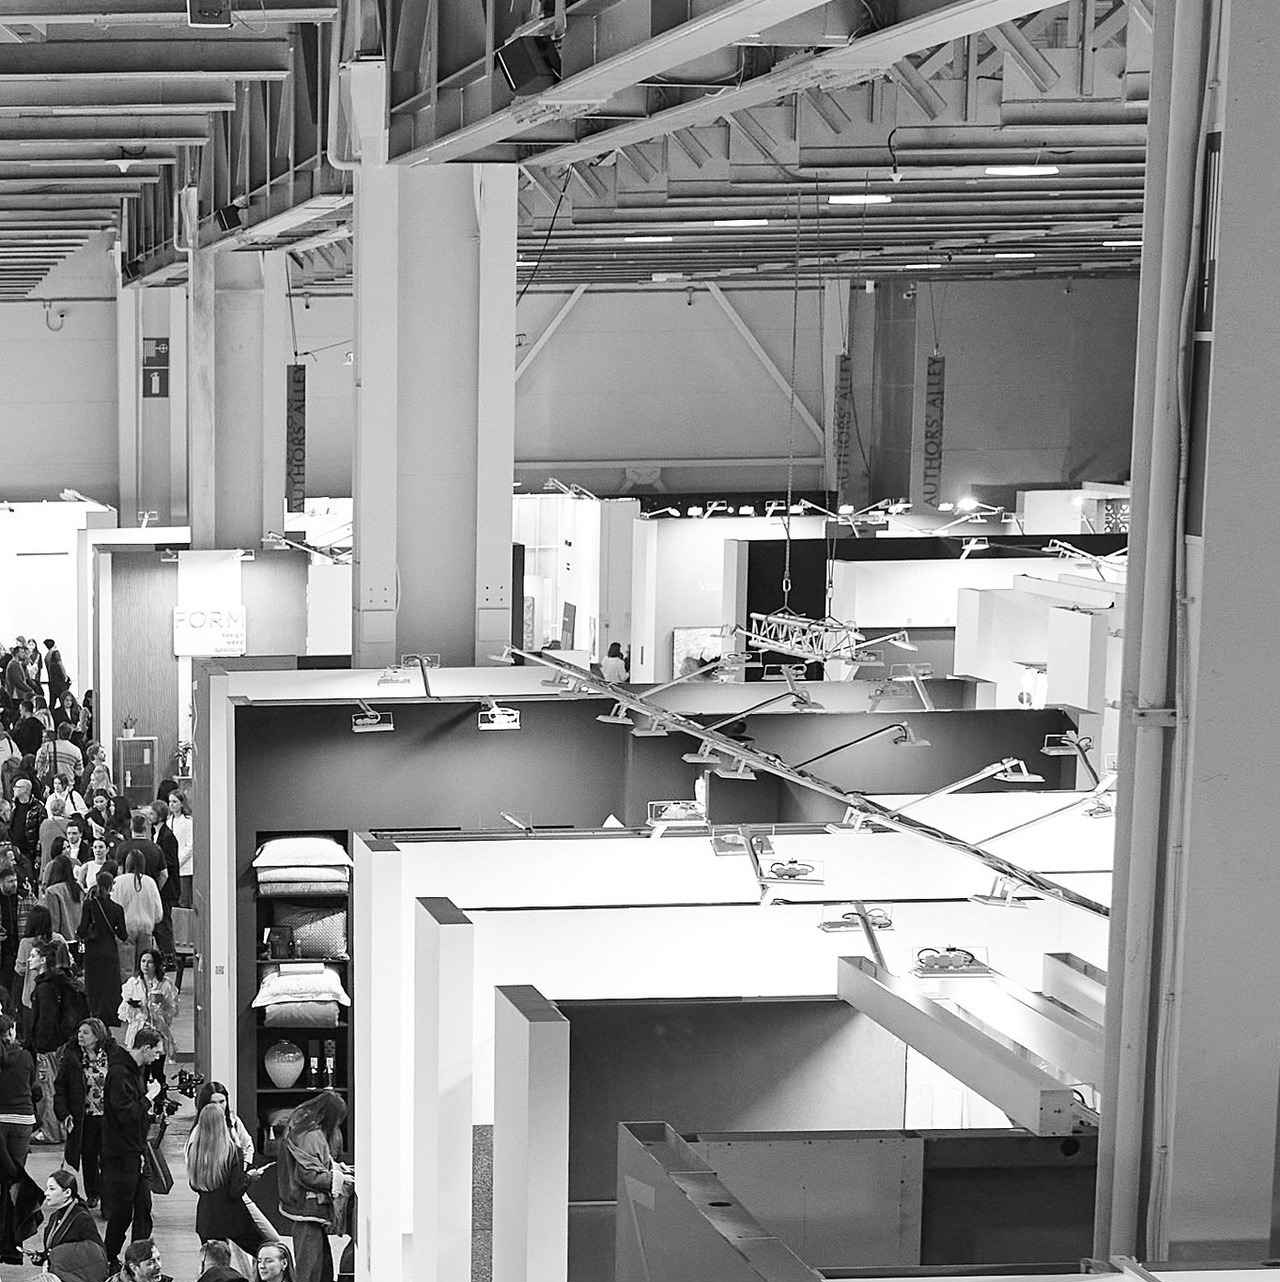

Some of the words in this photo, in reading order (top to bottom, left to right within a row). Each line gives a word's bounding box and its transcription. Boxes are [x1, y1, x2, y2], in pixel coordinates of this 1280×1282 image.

[293, 365, 306, 416] ALLEY
[840, 355, 852, 400] ALLEY
[927, 356, 944, 408] ALLEY
[176, 610, 244, 629] FORM
